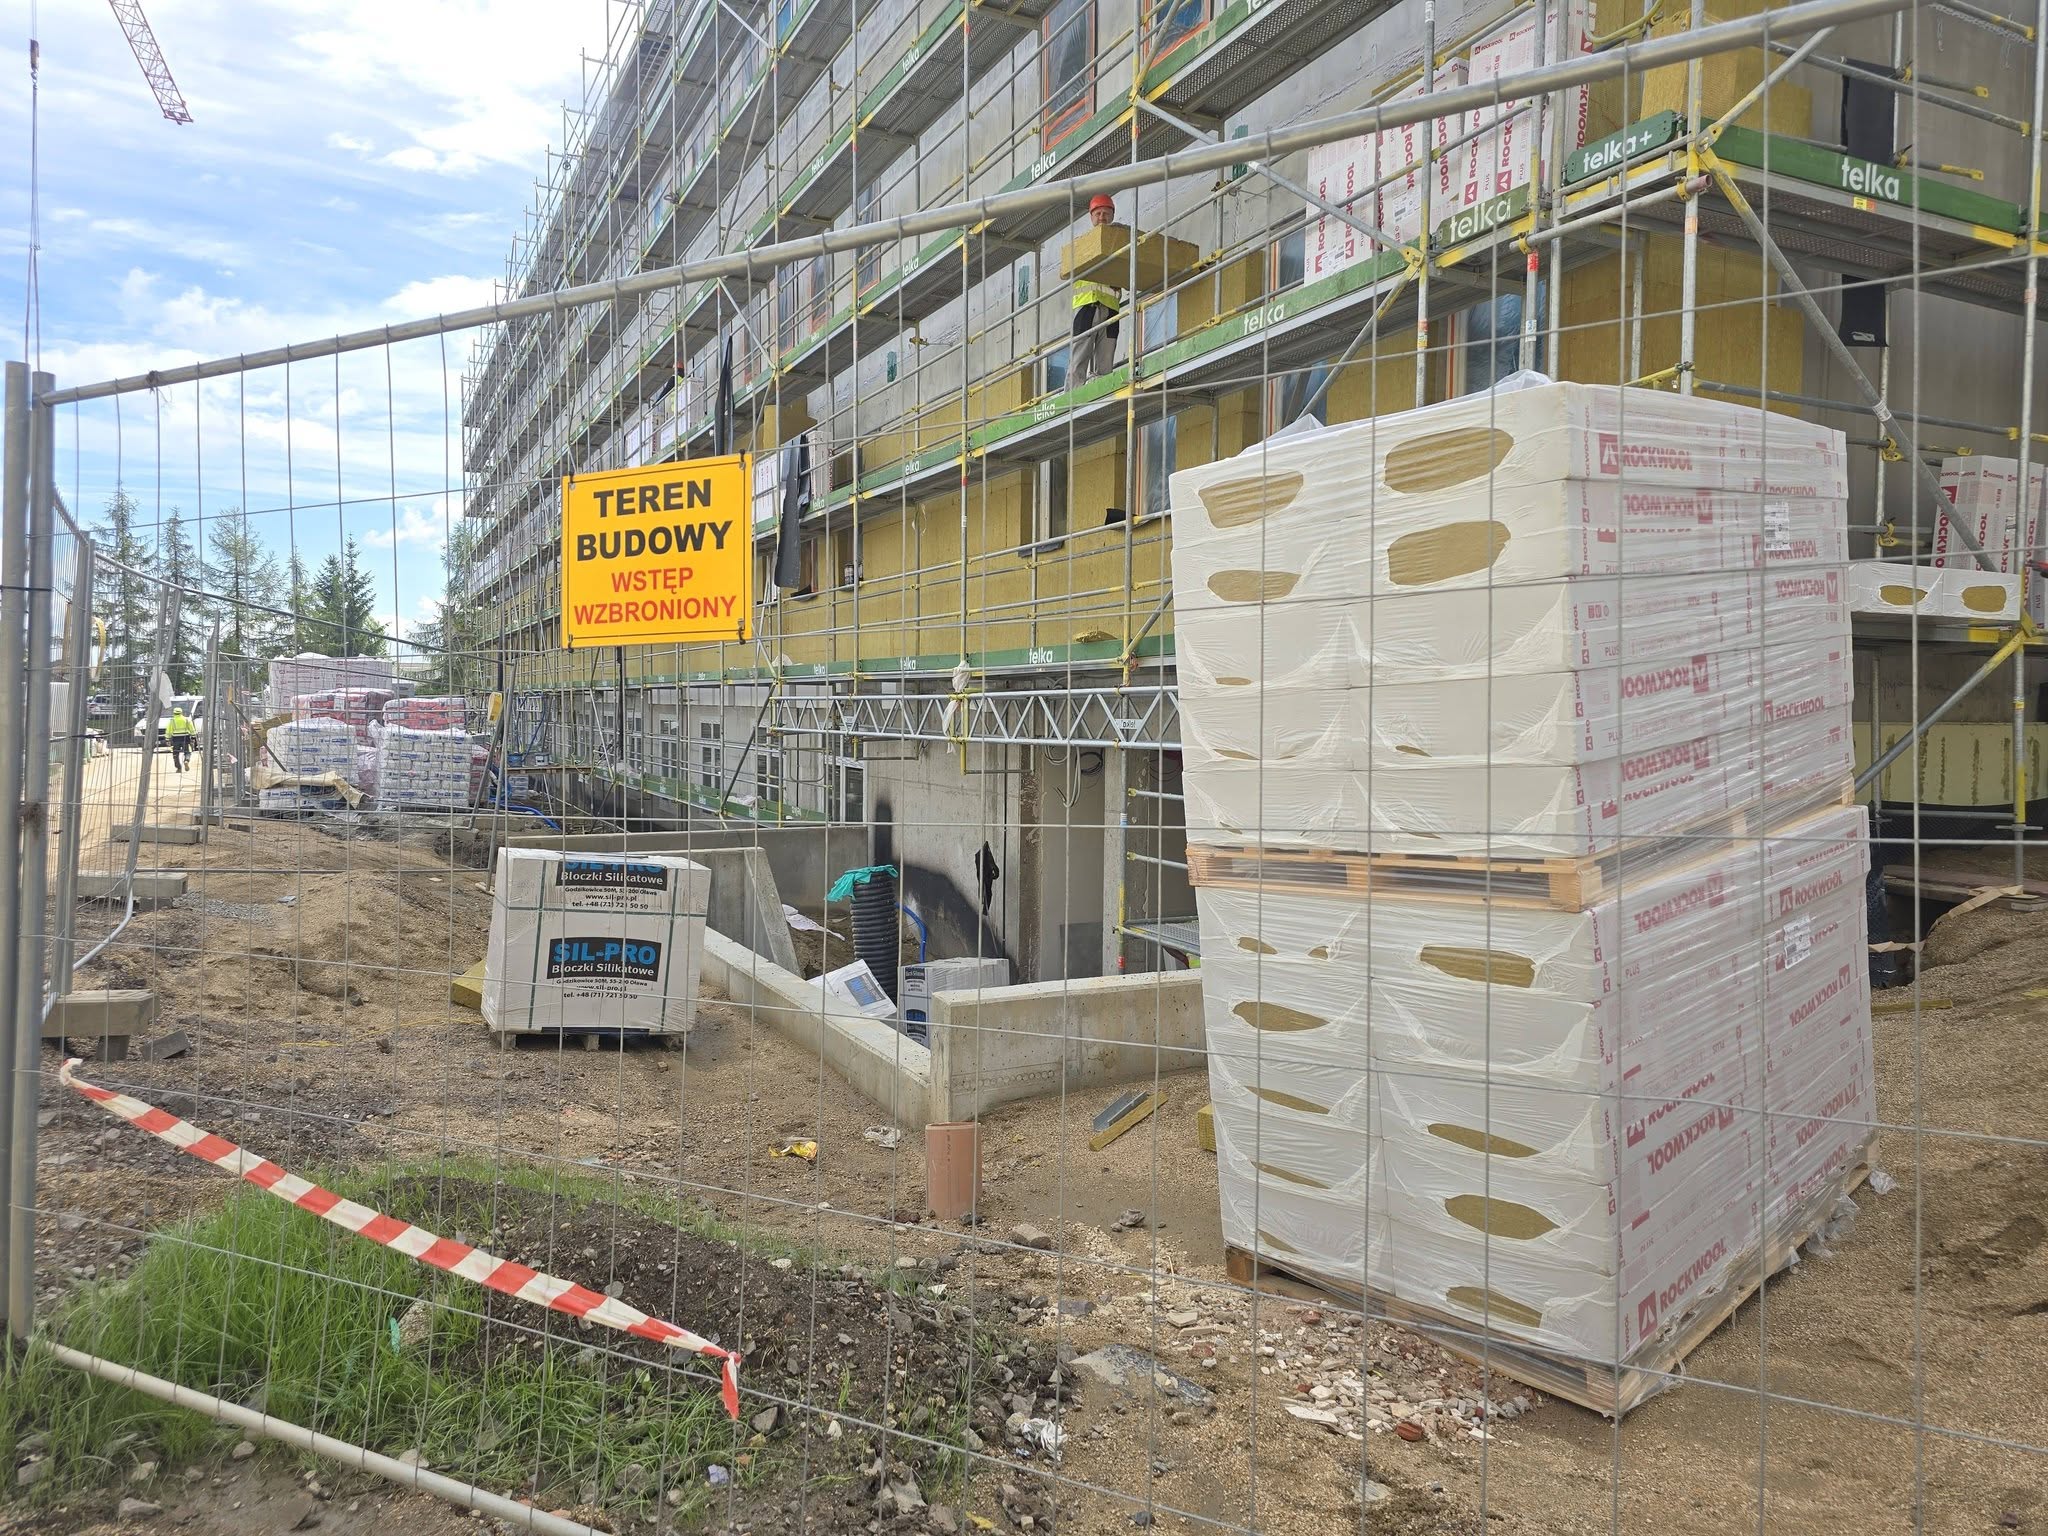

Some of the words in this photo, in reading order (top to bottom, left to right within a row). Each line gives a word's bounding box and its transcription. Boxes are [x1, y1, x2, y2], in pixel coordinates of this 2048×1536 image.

[1031, 151, 1056, 181] telka
[1842, 157, 1900, 201] telka
[1450, 197, 1512, 243] telka
[1034, 402, 1056, 422] telka
[904, 460, 920, 476] elka
[1622, 445, 1693, 471] ROCKWOOL
[593, 478, 712, 518] TEREN
[576, 520, 733, 561] BUDOWY
[611, 567, 694, 595] WSTĘP
[573, 595, 737, 625] WZBRONIONY
[1029, 647, 1053, 664] telka
[560, 871, 602, 882] Bloczki
[605, 872, 664, 885] Silikatowe
[1794, 870, 1844, 907] ROCKWOOL
[553, 942, 656, 965] SIL-PRO
[596, 963, 654, 976] Silikatowe
[1625, 964, 1640, 979] PLUS
[1788, 978, 1839, 1028] ROCKWOOL
[1647, 1111, 1716, 1175] ROCKWOOL
[1660, 1238, 1728, 1313] ROCKWOOL
